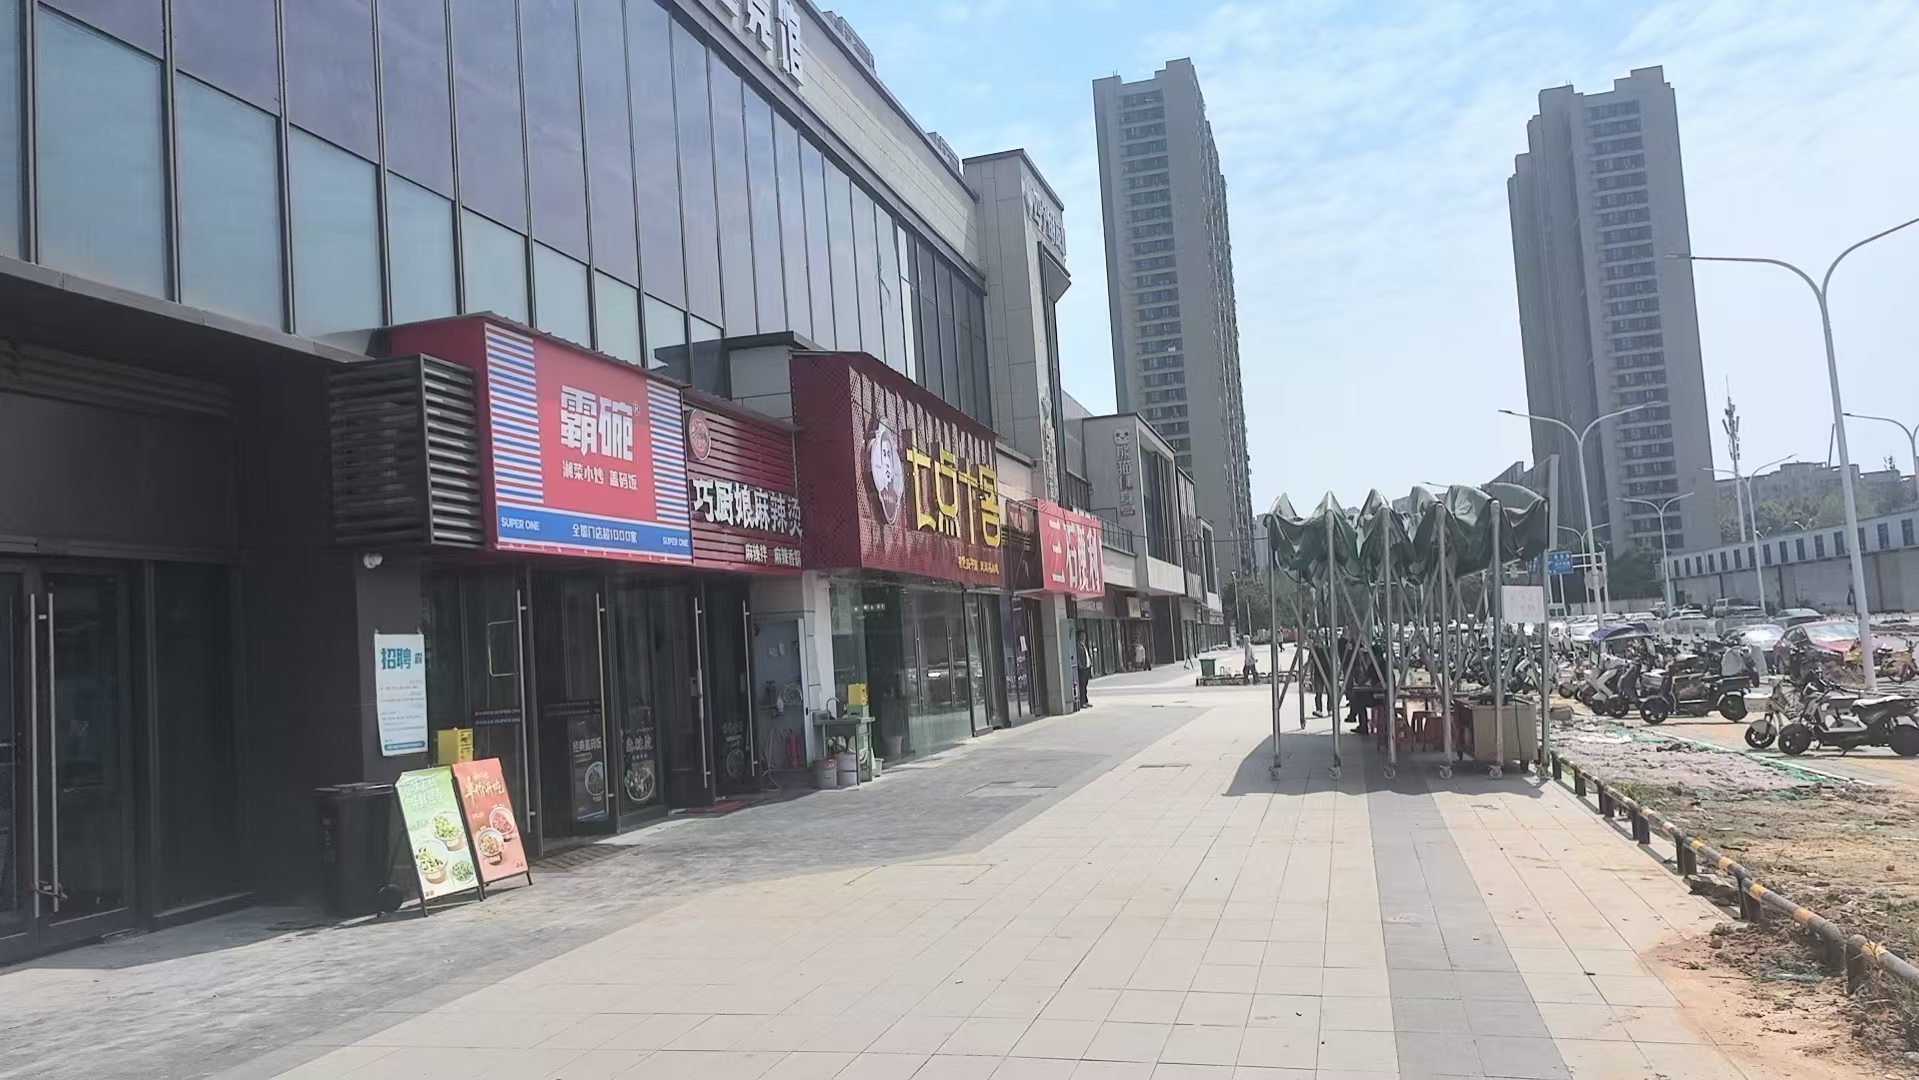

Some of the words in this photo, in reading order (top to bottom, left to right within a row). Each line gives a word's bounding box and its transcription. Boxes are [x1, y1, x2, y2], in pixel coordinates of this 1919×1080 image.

[560, 384, 633, 462] 霸碗
[562, 460, 604, 485] 湘菜小炒
[609, 469, 638, 491] 盖码饭
[692, 478, 803, 537] 巧厨娘麻辣烫
[501, 517, 525, 530] SUPER
[525, 521, 541, 532] ONE
[572, 523, 638, 543] 全国门店超1000家
[662, 536, 678, 546] SUPER
[678, 539, 690, 548] ONE
[745, 543, 768, 564] 麻辣拌
[381, 647, 411, 670] 招聘
